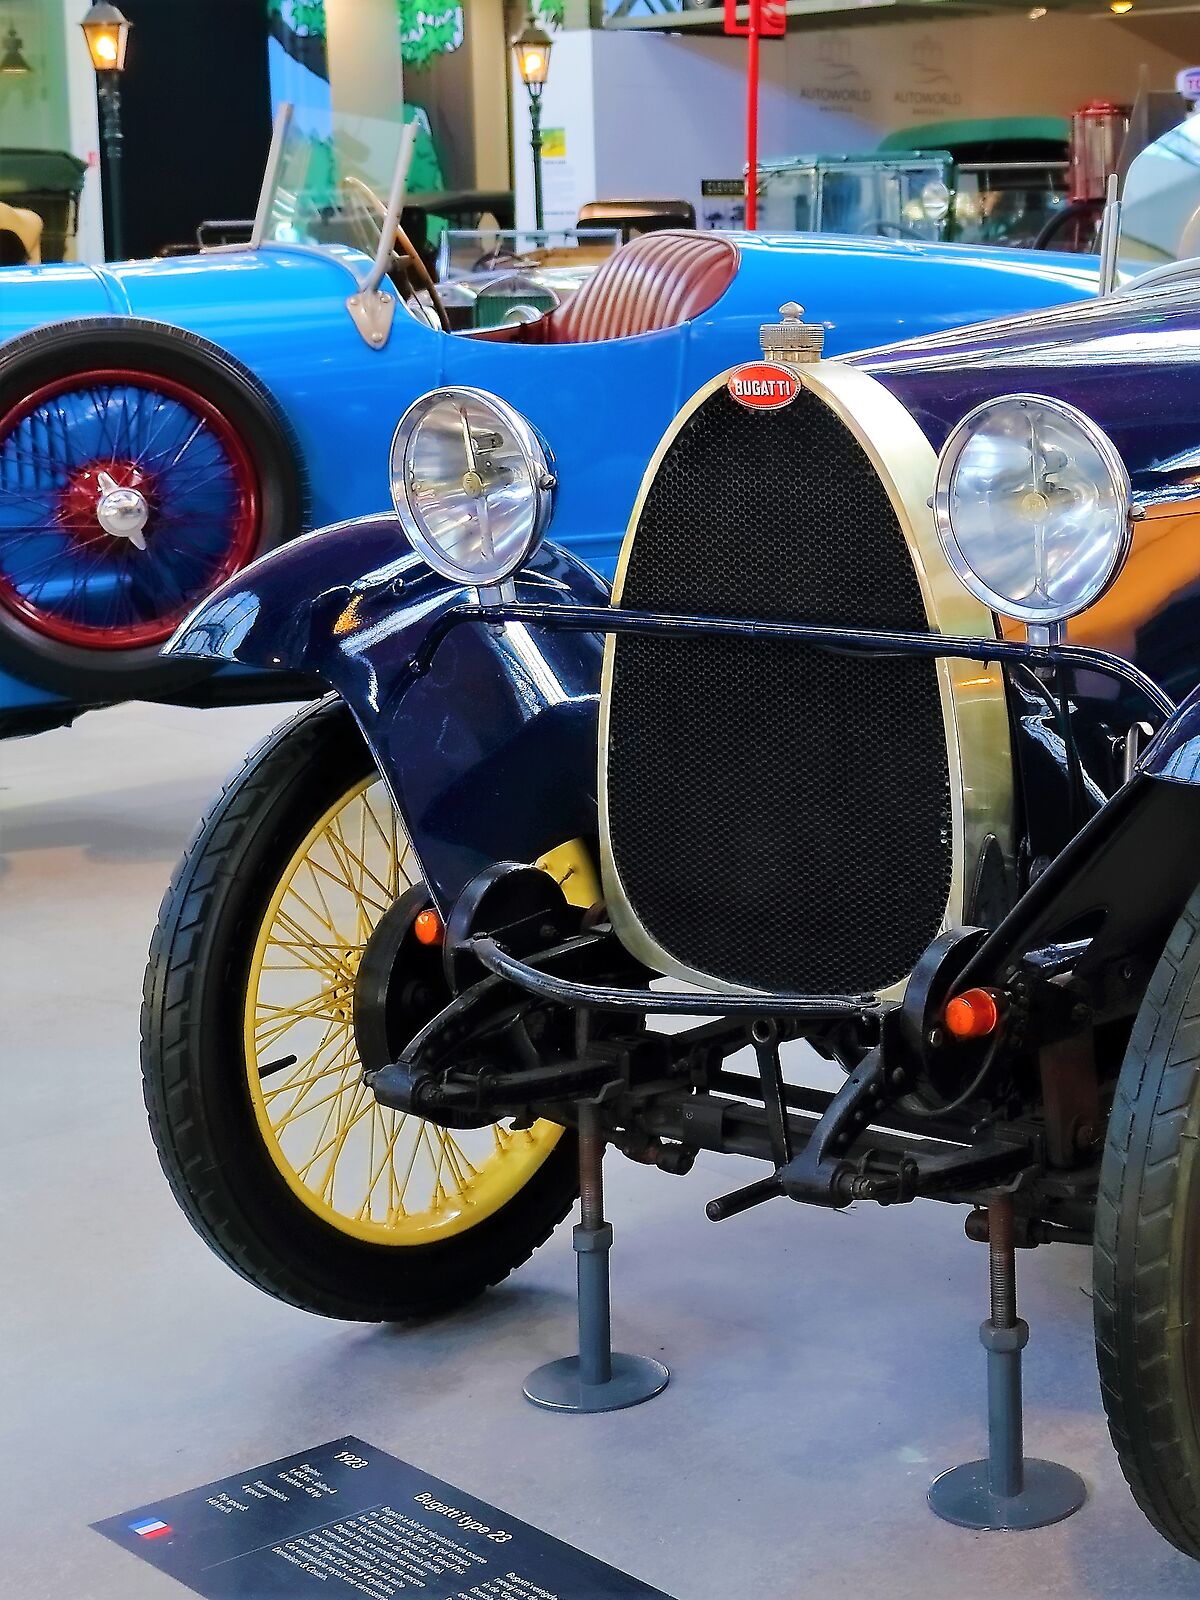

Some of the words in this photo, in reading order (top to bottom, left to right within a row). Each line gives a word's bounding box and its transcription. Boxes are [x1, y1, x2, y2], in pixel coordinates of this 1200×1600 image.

[800, 88, 871, 102] AUTOWORLD
[894, 92, 961, 105] AUTOWORLD
[735, 380, 791, 396] BUGATTI
[334, 1451, 369, 1469] 1923
[414, 1492, 466, 1519] Bugatti
[457, 1515, 490, 1533] type
[487, 1530, 512, 1543] 23
